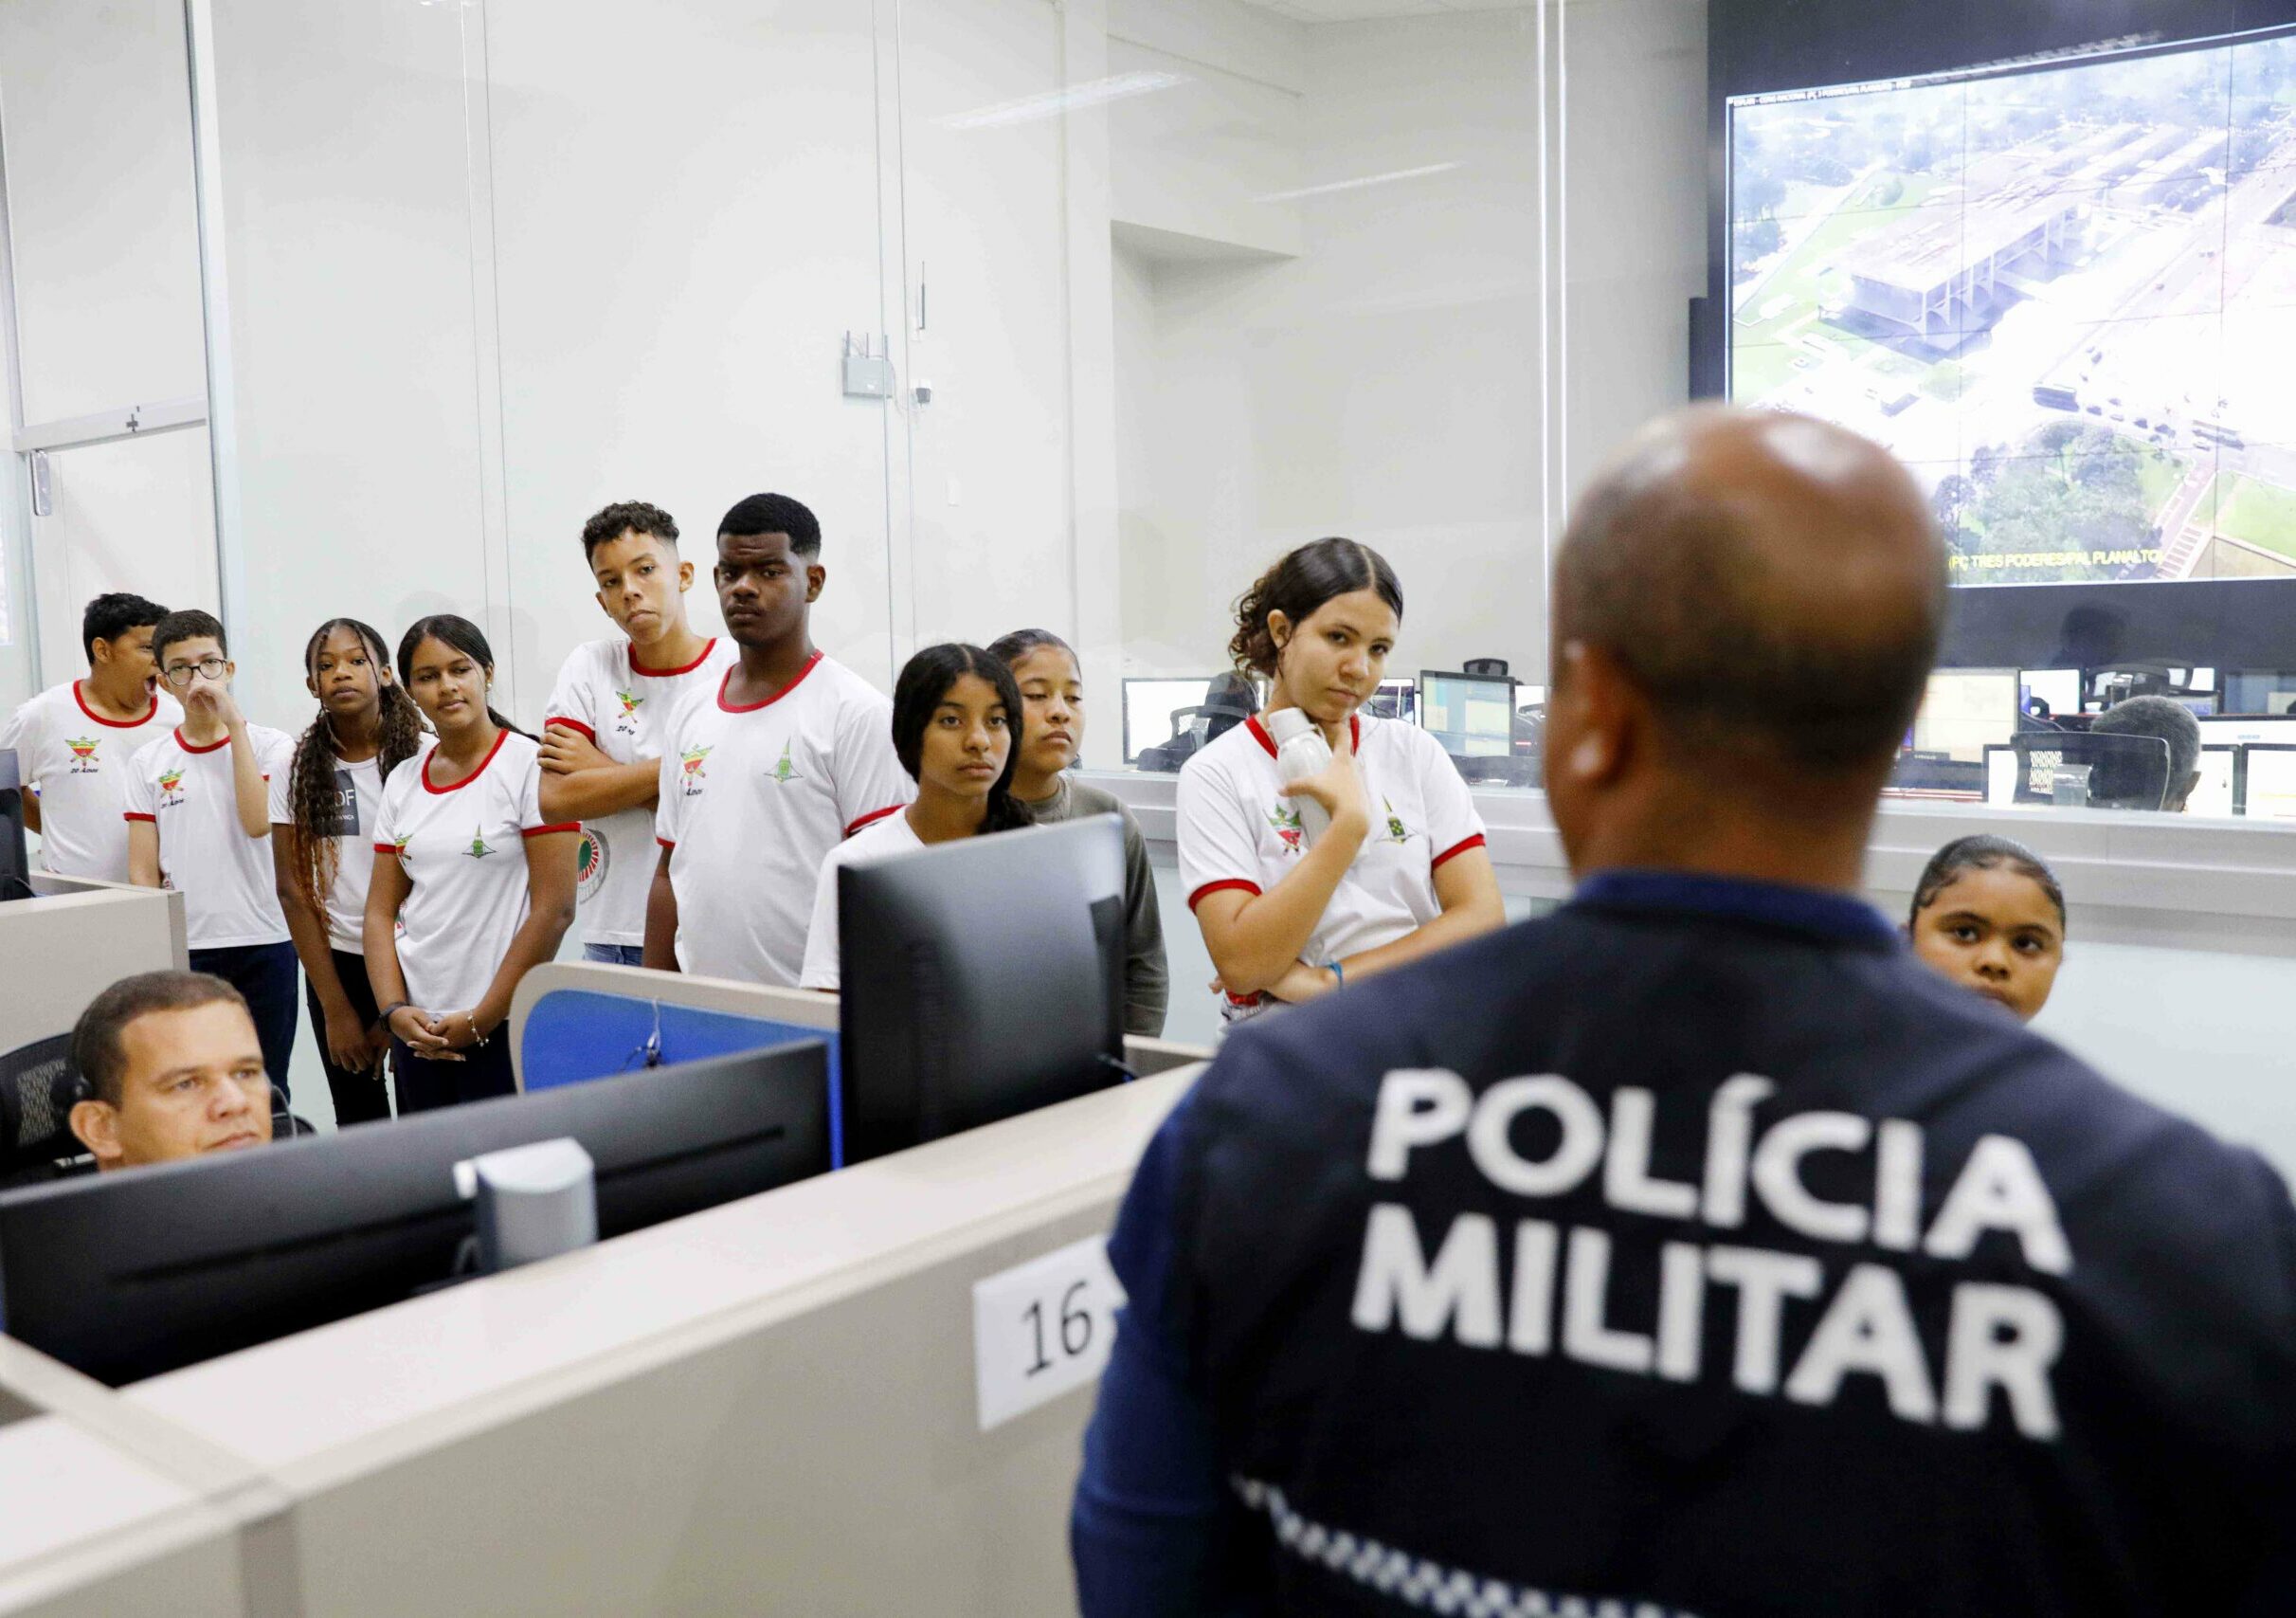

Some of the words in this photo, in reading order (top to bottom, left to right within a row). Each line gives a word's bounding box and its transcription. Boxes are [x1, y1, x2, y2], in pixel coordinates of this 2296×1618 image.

[1366, 1066, 2072, 1276] POLÍCIA
[1021, 1280, 1093, 1379] 16
[1351, 1203, 2067, 1442] MILITAR
